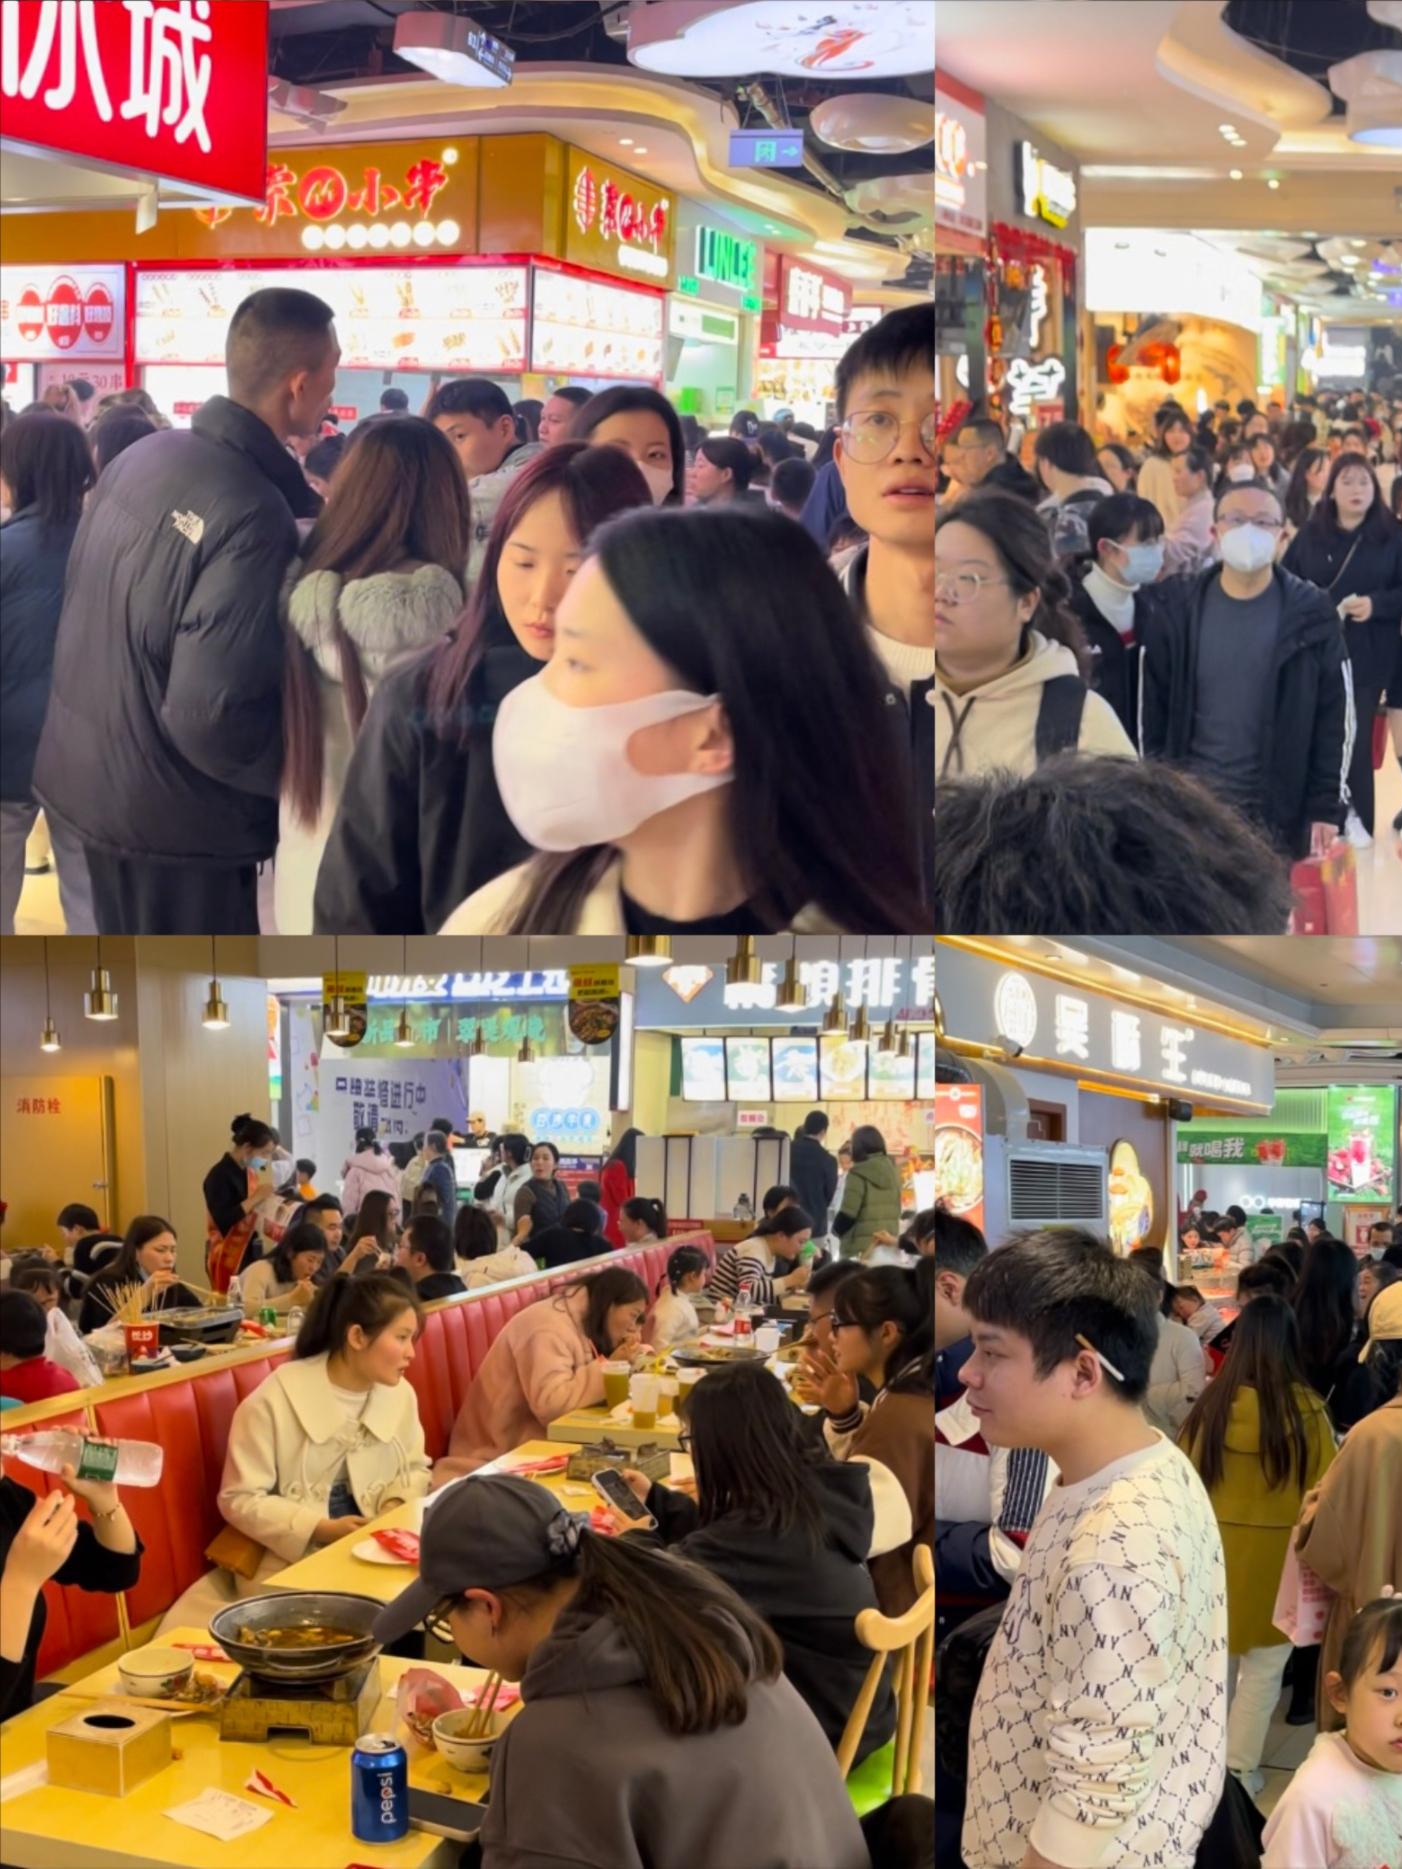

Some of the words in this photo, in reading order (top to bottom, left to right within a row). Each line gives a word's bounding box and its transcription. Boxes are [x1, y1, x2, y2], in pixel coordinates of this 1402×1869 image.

[16, 1098, 61, 1114] 消防栓
[377, 1771, 397, 1825] pepsi
